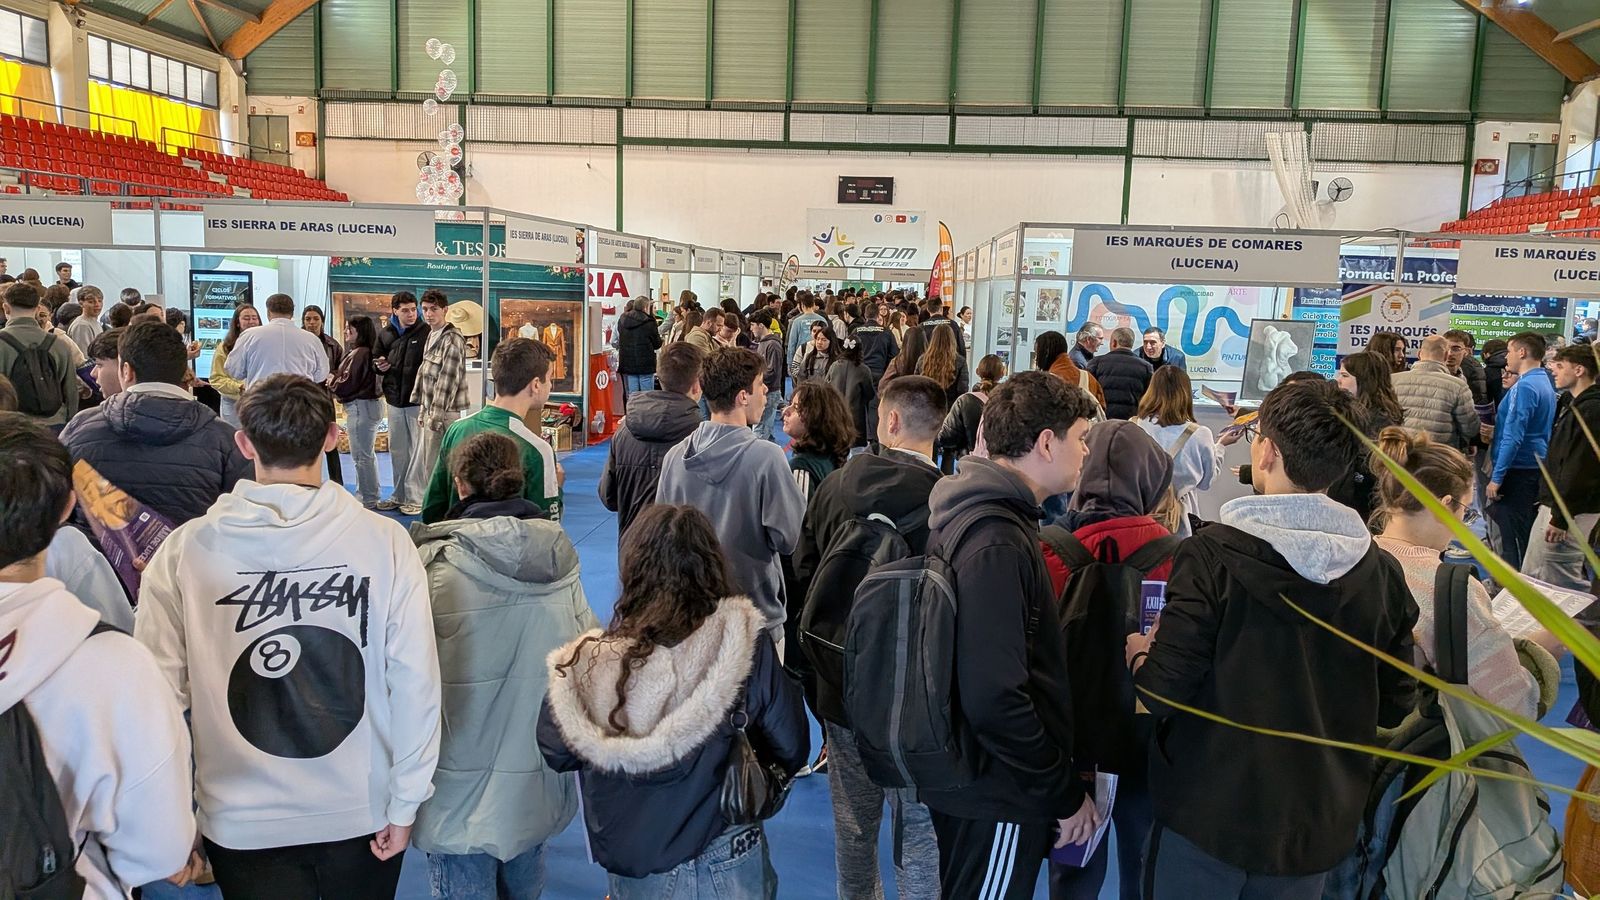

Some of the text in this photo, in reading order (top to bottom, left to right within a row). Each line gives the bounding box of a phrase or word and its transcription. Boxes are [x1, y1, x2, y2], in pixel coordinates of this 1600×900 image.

[0, 215, 84, 229] RAS (LUCENA)
[208, 219, 397, 237] IES SIERRA DE ARAS (LUCENA)
[518, 230, 534, 240] SIERRA
[535, 232, 541, 240] DE
[541, 232, 552, 242] ARAS
[552, 234, 569, 245] (LUCENA)
[1106, 235, 1303, 250] IES MARQUÉS DE COMARES
[435, 242, 448, 256] &
[860, 247, 918, 259] SDM
[1495, 248, 1596, 261] IES MARQUÉS
[460, 264, 483, 273] Vintag
[854, 259, 910, 267] Lucena
[1171, 257, 1239, 272] (LUCENA)
[1554, 269, 1600, 281] (LUCE
[1350, 325, 1370, 334] IES
[1374, 324, 1437, 337] MARQUÉS
[1352, 337, 1369, 346] DE
[259, 640, 291, 671] 8
